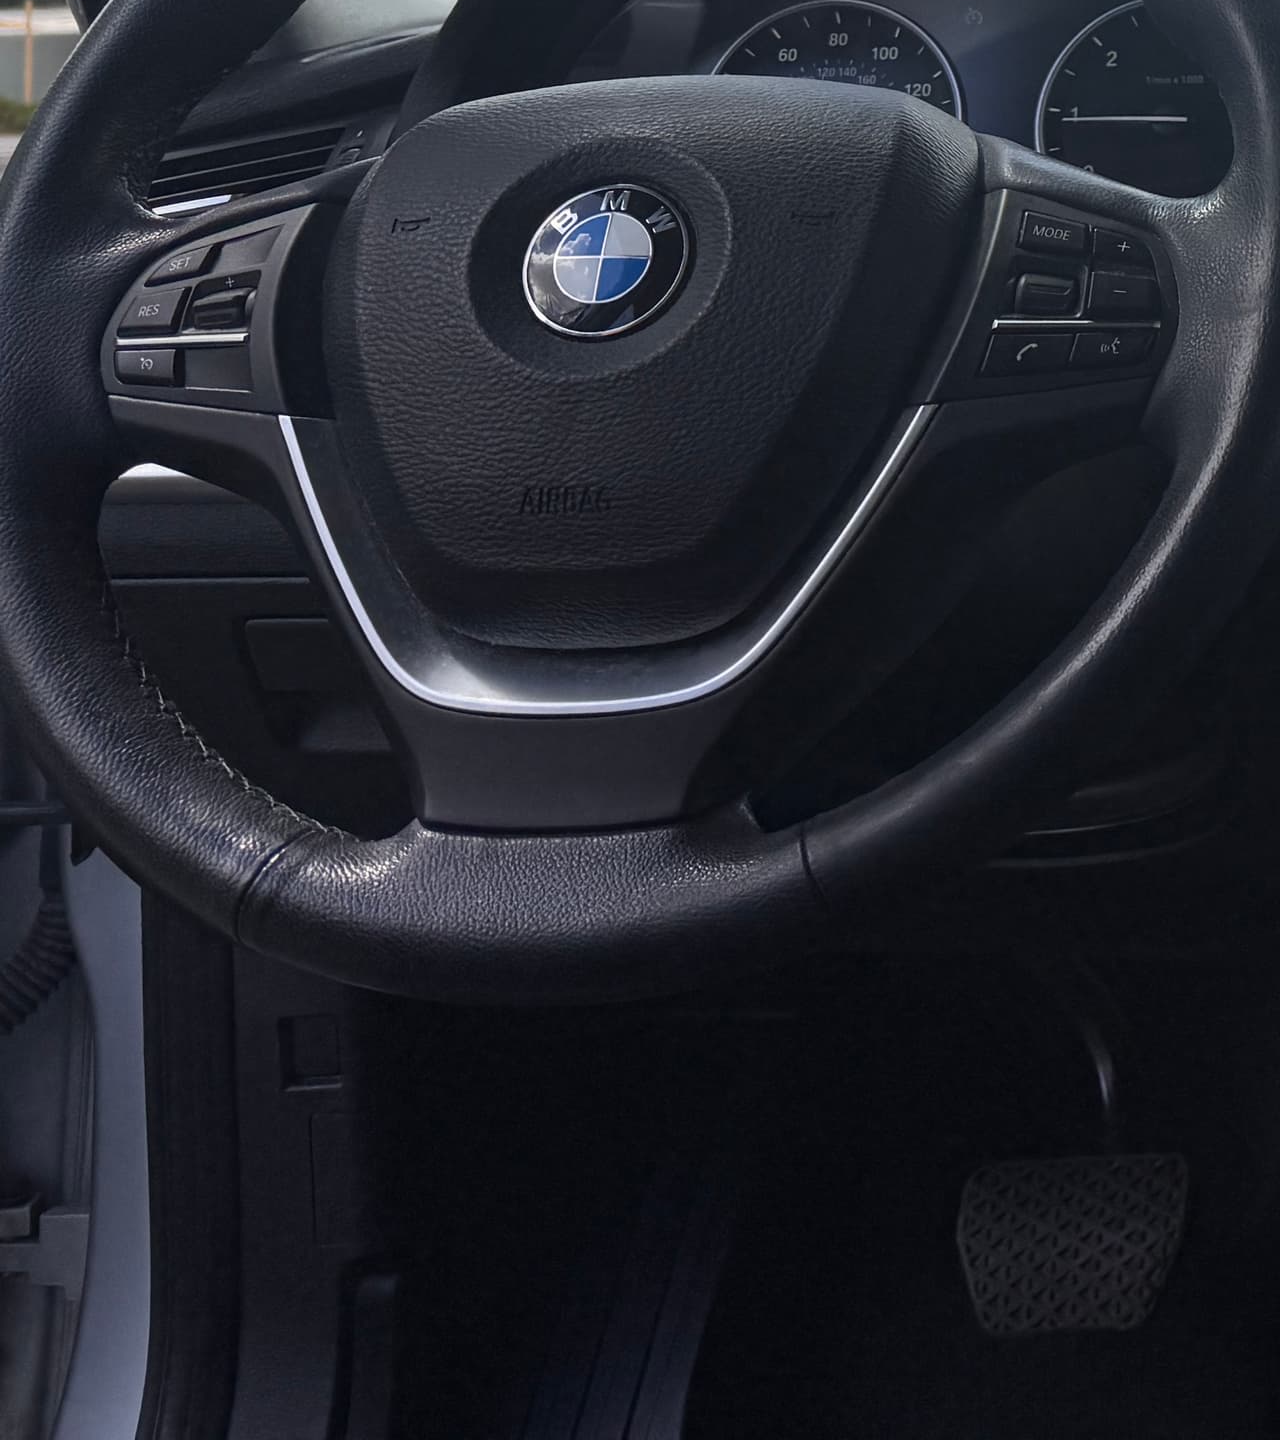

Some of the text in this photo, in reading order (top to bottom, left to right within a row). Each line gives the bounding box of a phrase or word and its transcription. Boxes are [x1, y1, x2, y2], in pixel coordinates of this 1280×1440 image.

[829, 33, 848, 47] 80
[778, 48, 798, 62] 60
[872, 46, 898, 61] 100
[1105, 50, 1118, 67] 2
[904, 83, 932, 97] 120
[551, 190, 677, 234] BMW
[1032, 225, 1072, 241] MODE
[169, 257, 192, 271] SET
[138, 304, 160, 317] RES
[519, 487, 611, 514] AIRBAG
